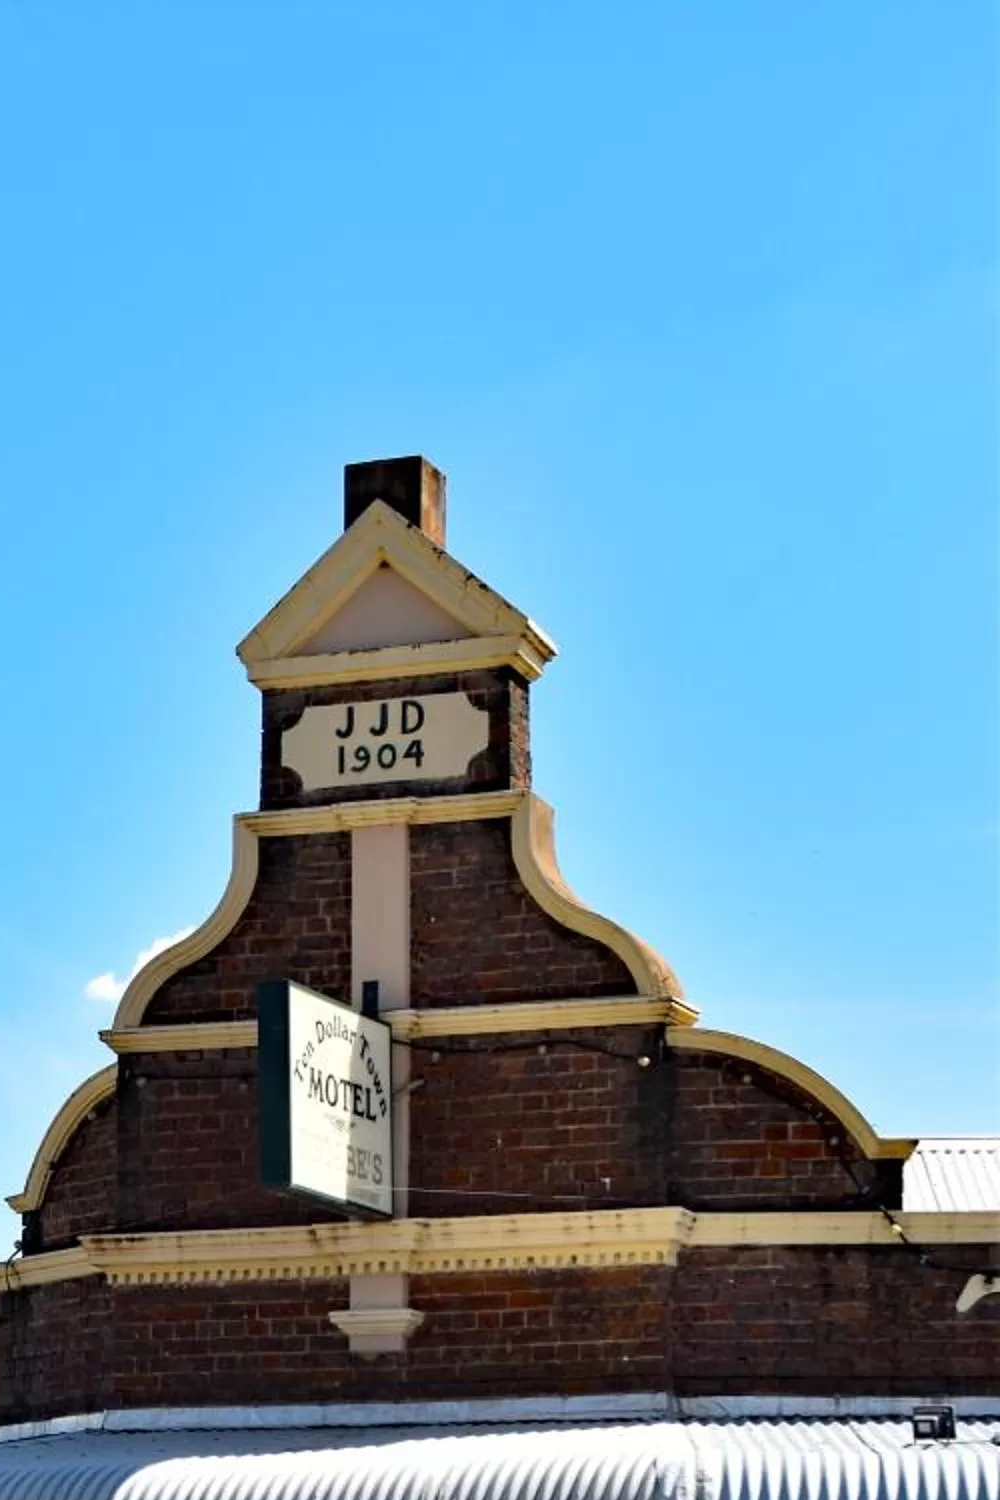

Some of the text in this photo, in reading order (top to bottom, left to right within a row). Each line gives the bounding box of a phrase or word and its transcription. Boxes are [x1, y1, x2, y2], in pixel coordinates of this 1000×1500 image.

[337, 739, 425, 775] 1904
[294, 1014, 388, 1118] Ten Dollar Town
[307, 1066, 377, 1122] MOTEL
